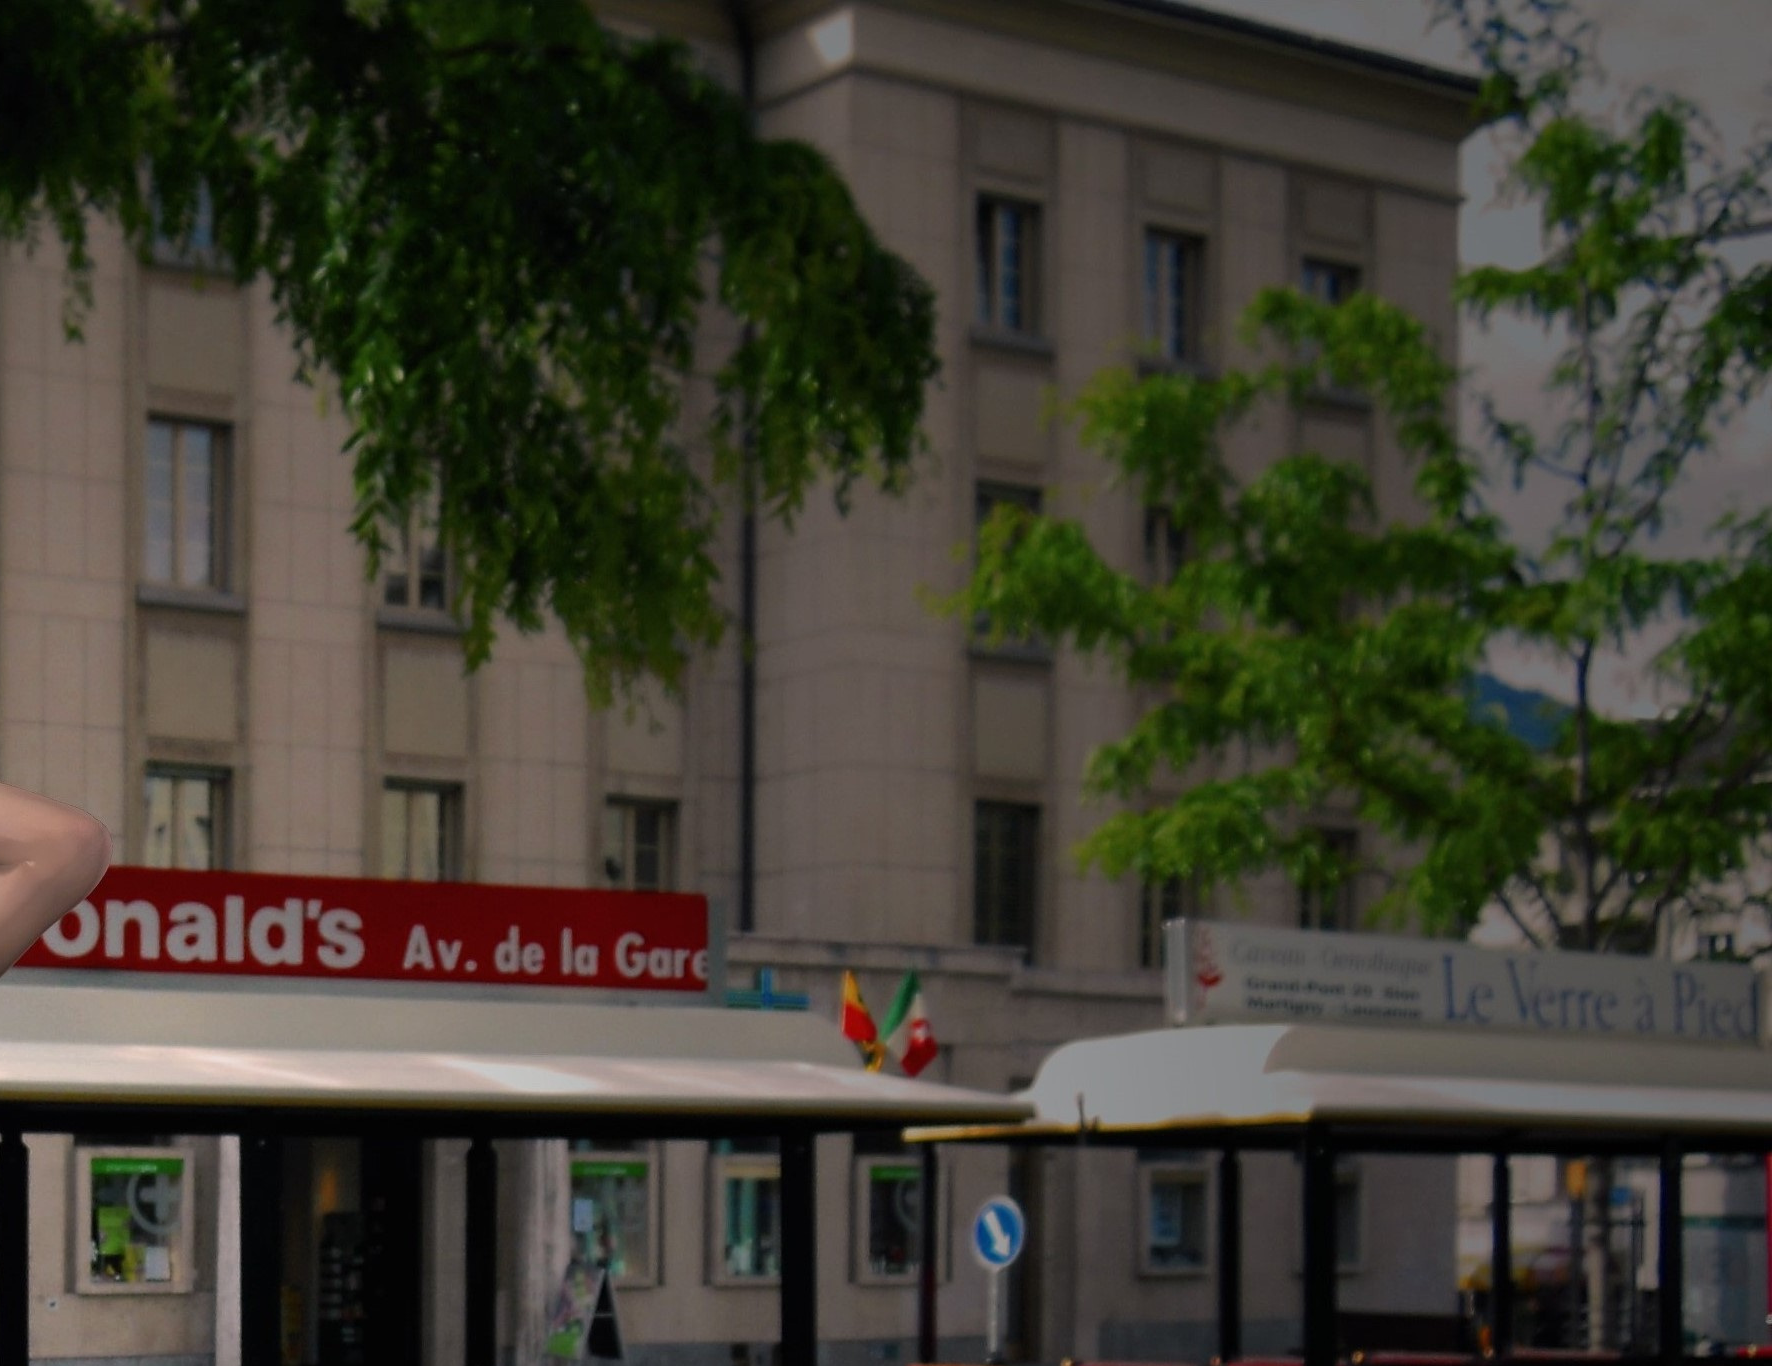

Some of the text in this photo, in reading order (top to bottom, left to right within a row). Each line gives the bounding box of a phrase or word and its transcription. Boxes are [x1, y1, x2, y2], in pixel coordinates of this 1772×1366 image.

[401, 923, 478, 973] Av.
[493, 924, 546, 976] de
[559, 925, 599, 977] la
[614, 930, 708, 982] Gare
[1441, 954, 1758, 1041] Le Verre à Pied
